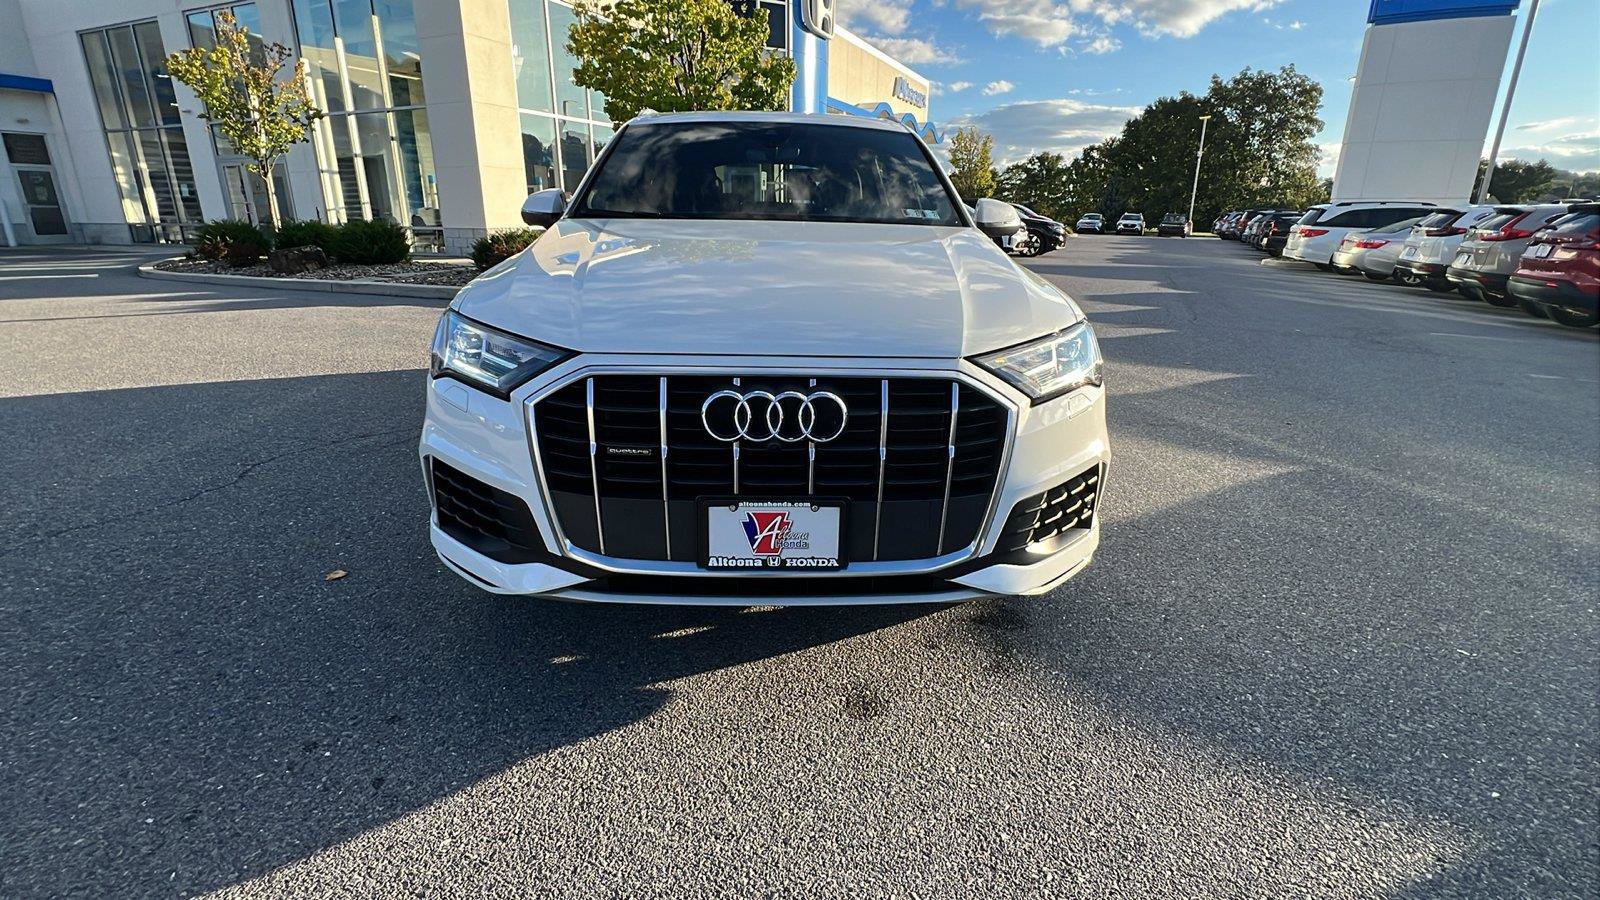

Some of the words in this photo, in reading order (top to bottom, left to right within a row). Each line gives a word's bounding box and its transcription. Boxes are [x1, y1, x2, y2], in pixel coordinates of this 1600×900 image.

[609, 447, 649, 455] quattro
[775, 540, 809, 549] Honda
[708, 556, 763, 567] Altoona
[785, 557, 839, 567] HONDA
